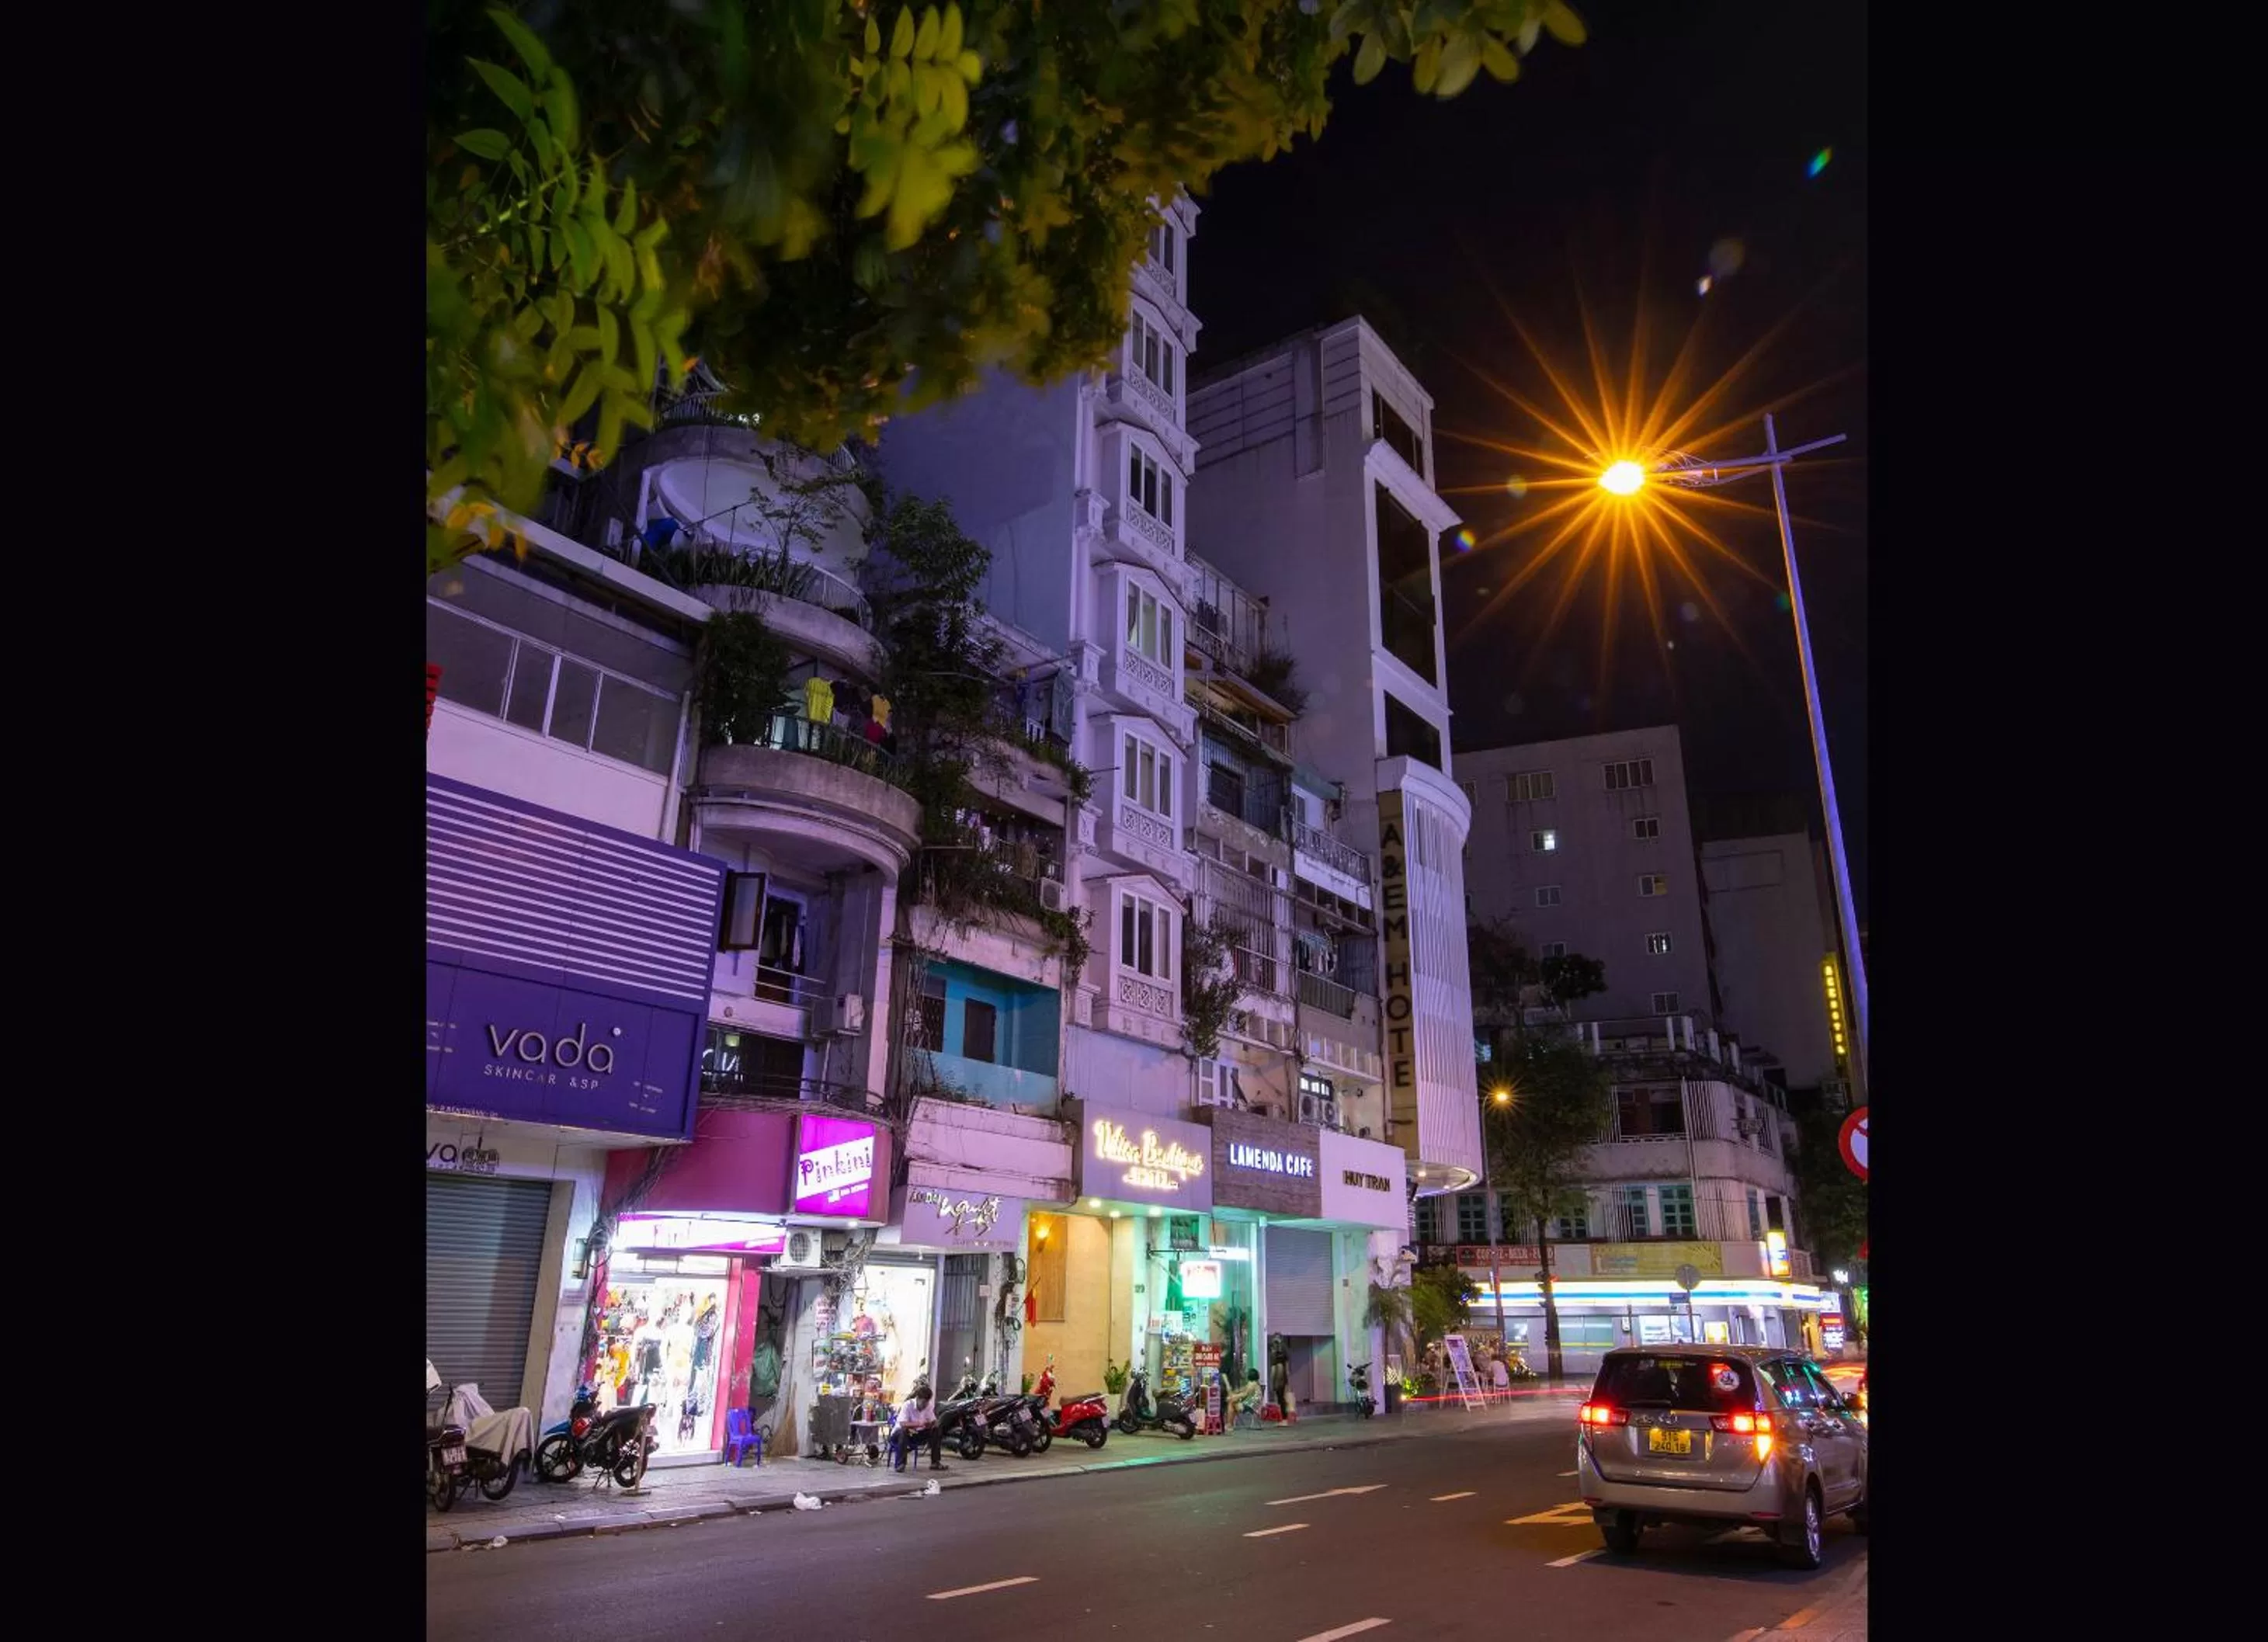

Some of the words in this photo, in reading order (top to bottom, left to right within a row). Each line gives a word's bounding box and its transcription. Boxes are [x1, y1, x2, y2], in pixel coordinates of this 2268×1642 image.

[488, 1022, 614, 1074] vada
[1229, 1142, 1283, 1174] LAMENDA
[1286, 1152, 1314, 1178] CAFE
[1342, 1170, 1363, 1188] HUY
[1365, 1174, 1391, 1192] TRAN
